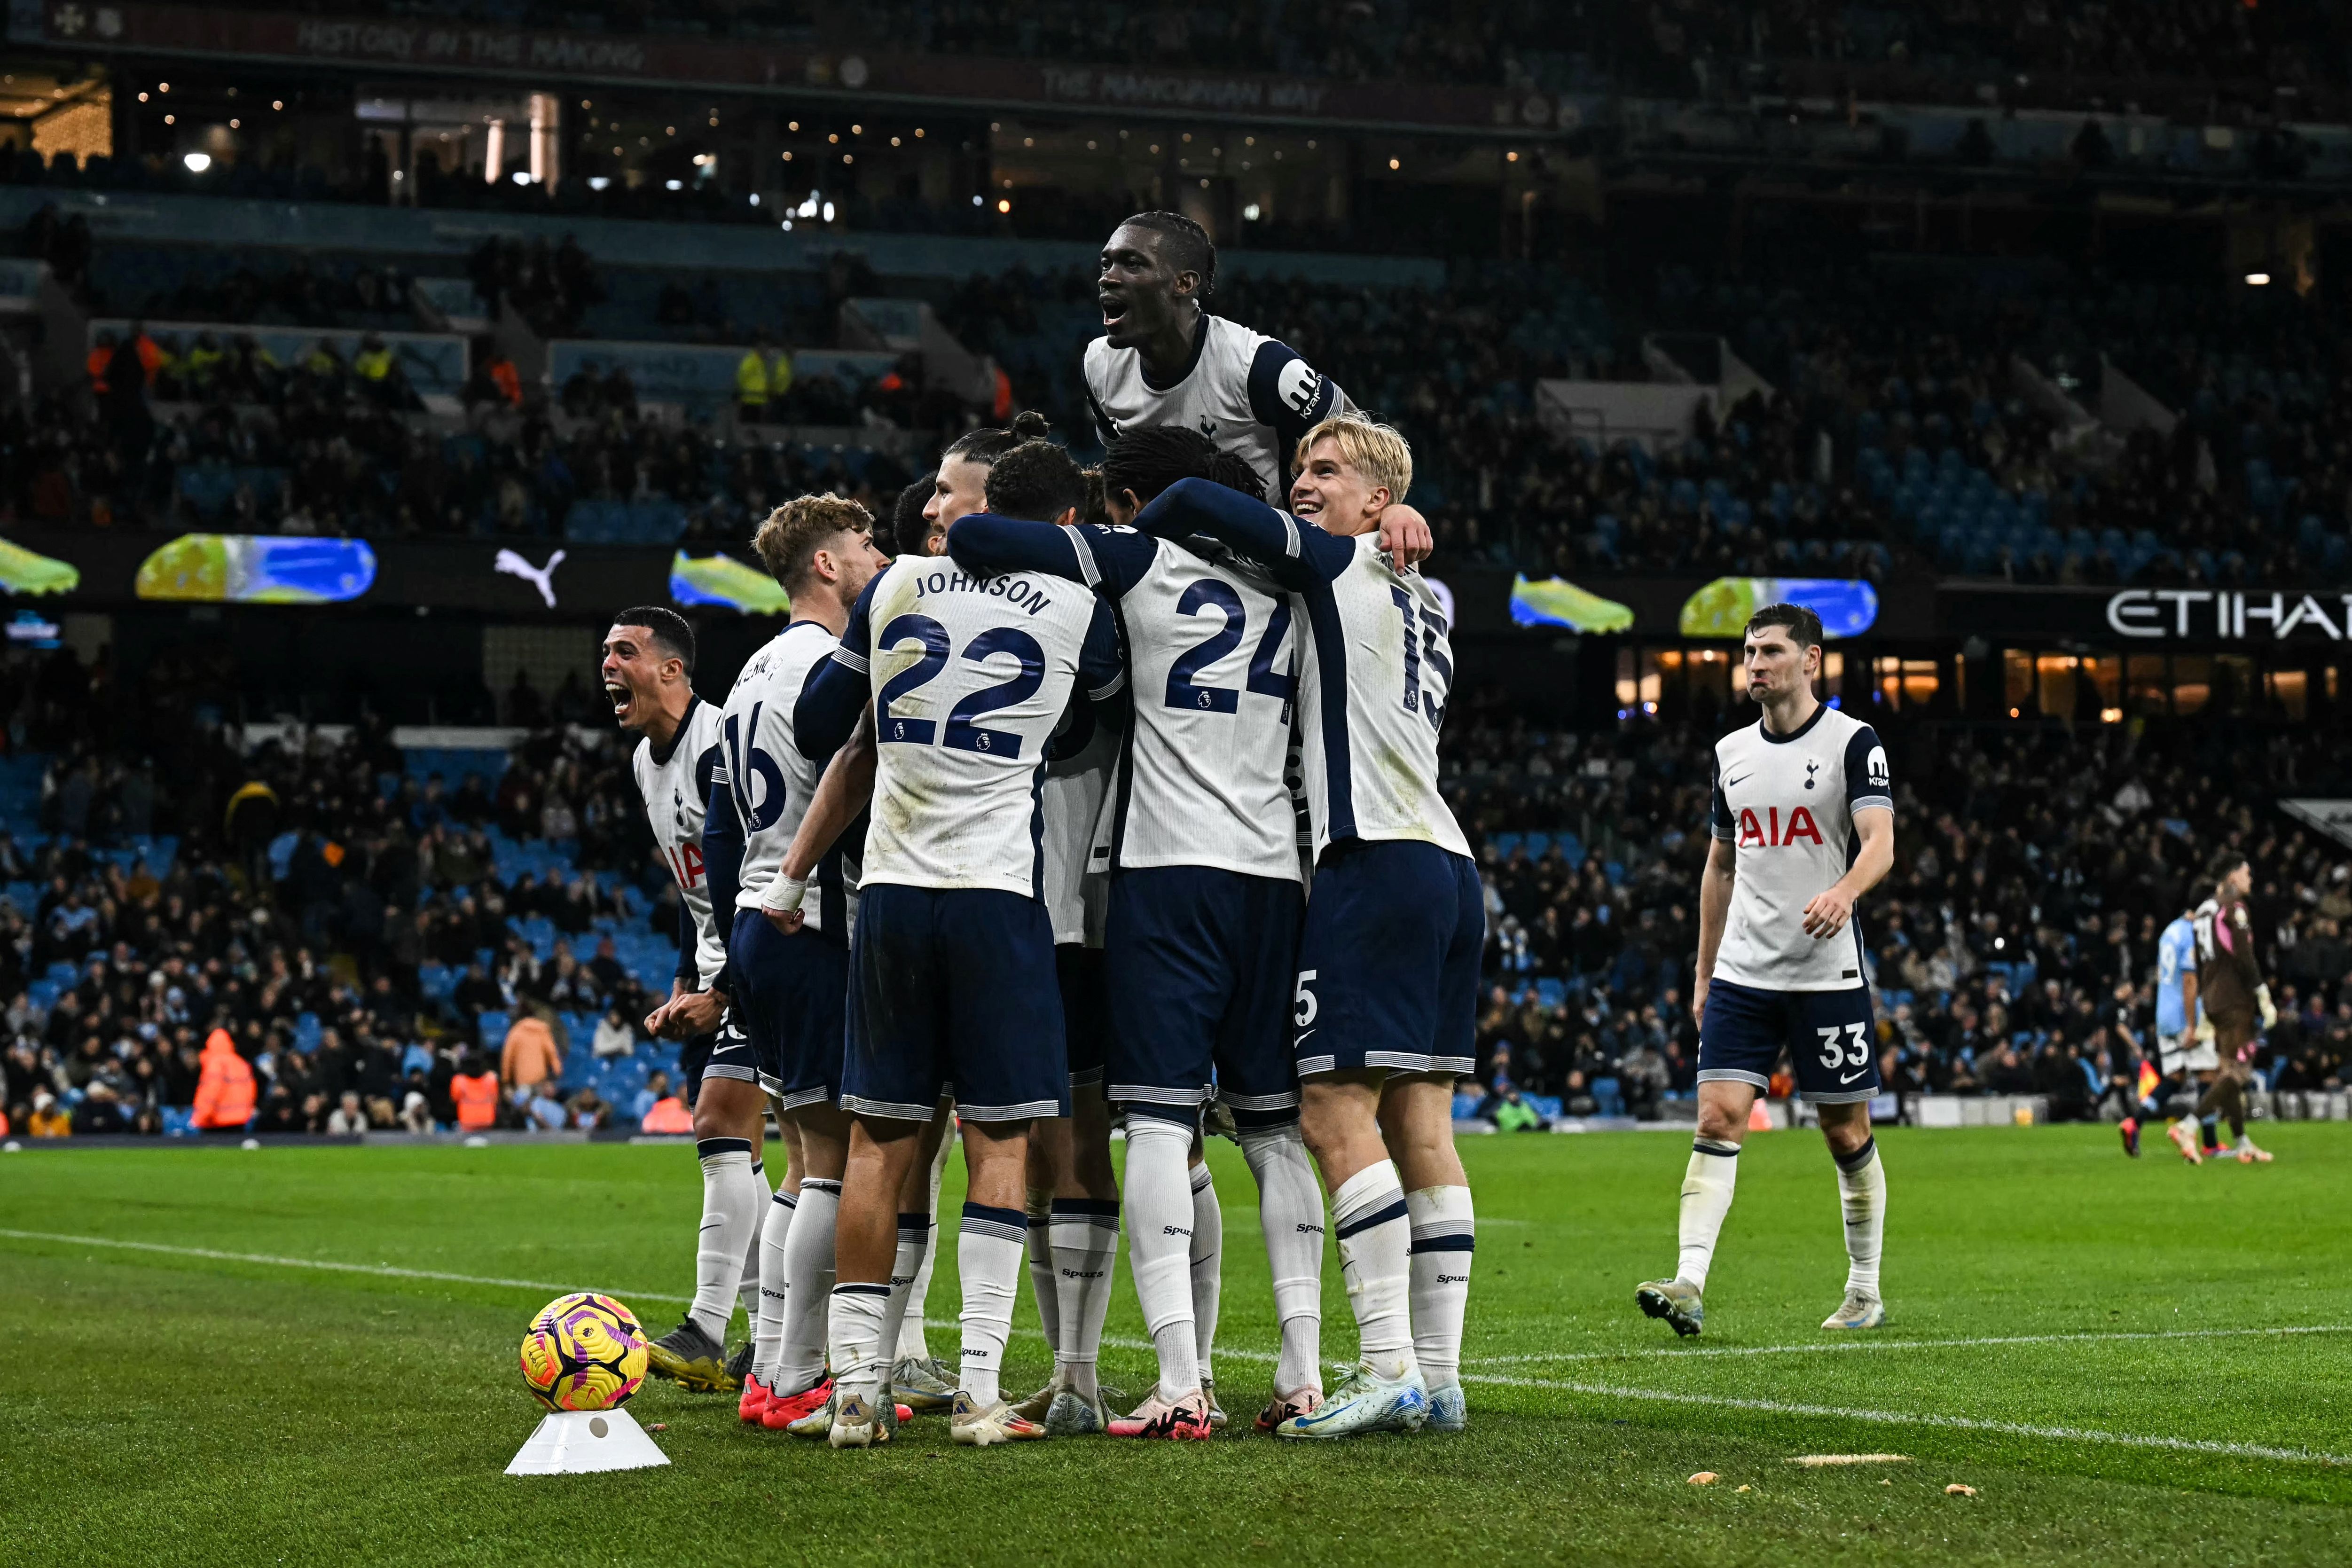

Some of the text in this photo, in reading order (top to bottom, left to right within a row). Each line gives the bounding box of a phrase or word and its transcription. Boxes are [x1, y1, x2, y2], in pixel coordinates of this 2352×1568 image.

[916, 572, 1051, 616] JOHNSON
[1164, 578, 1298, 726] 24
[1390, 584, 1454, 732] 15
[878, 613, 1046, 760] 22
[725, 701, 786, 838] 16
[1739, 806, 1823, 847] AIA
[669, 842, 705, 889] IA
[1294, 969, 1317, 1028] 5
[1817, 1021, 1869, 1069] 33
[1062, 1269, 1104, 1278] Spurs
[1437, 1274, 1468, 1284] Spurs
